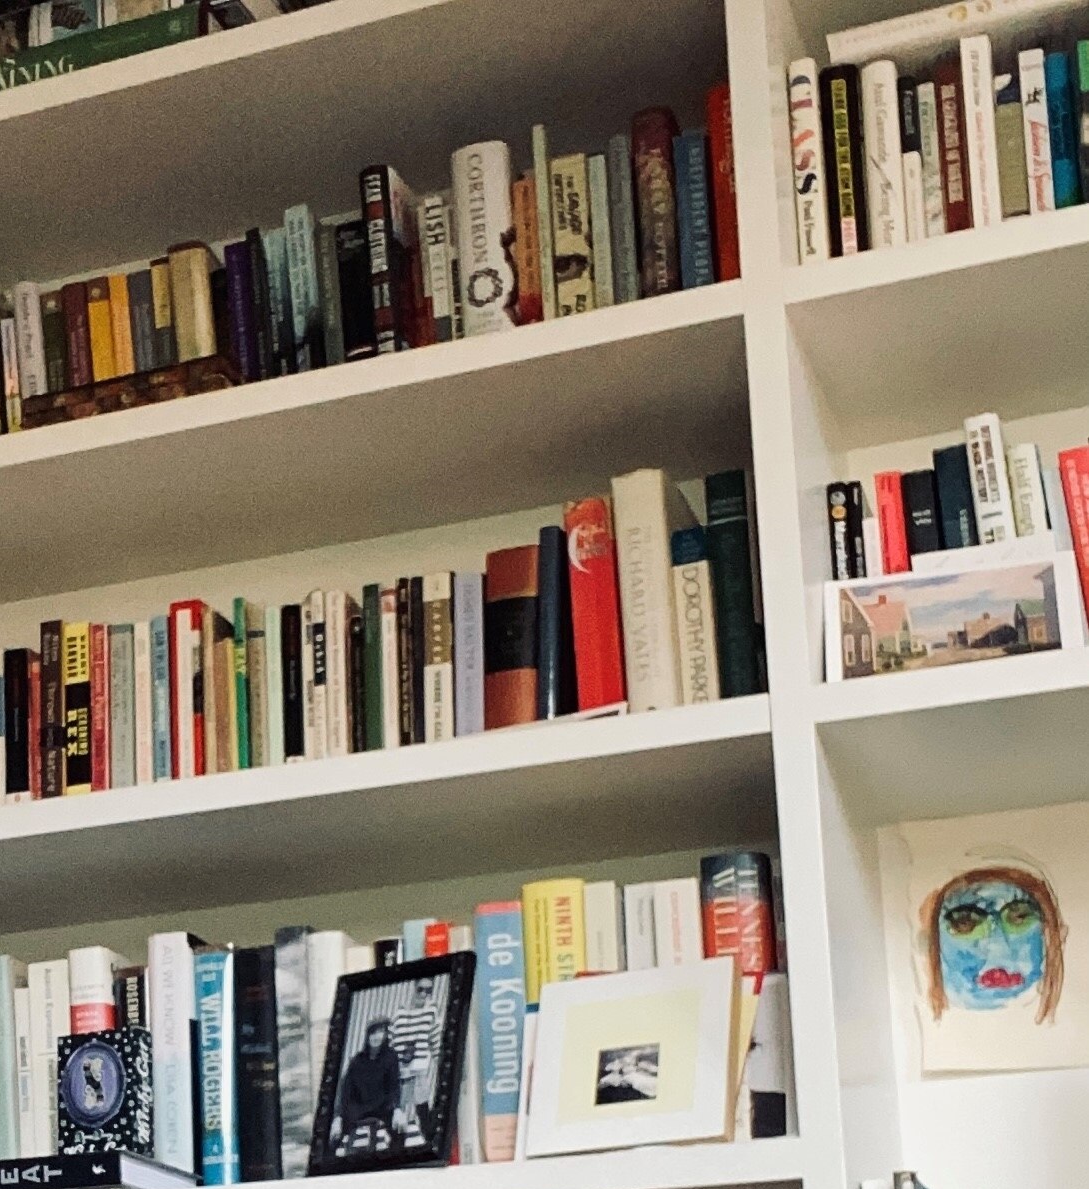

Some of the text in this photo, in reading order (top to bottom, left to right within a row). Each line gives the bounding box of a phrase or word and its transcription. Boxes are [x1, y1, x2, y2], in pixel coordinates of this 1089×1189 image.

[424, 204, 444, 245] LISH
[626, 527, 645, 615] RICHARD
[682, 565, 706, 652] DOROTHY
[555, 896, 573, 947] NINTH
[163, 994, 174, 1044] KNOW
[486, 933, 523, 1094] de Kooning
